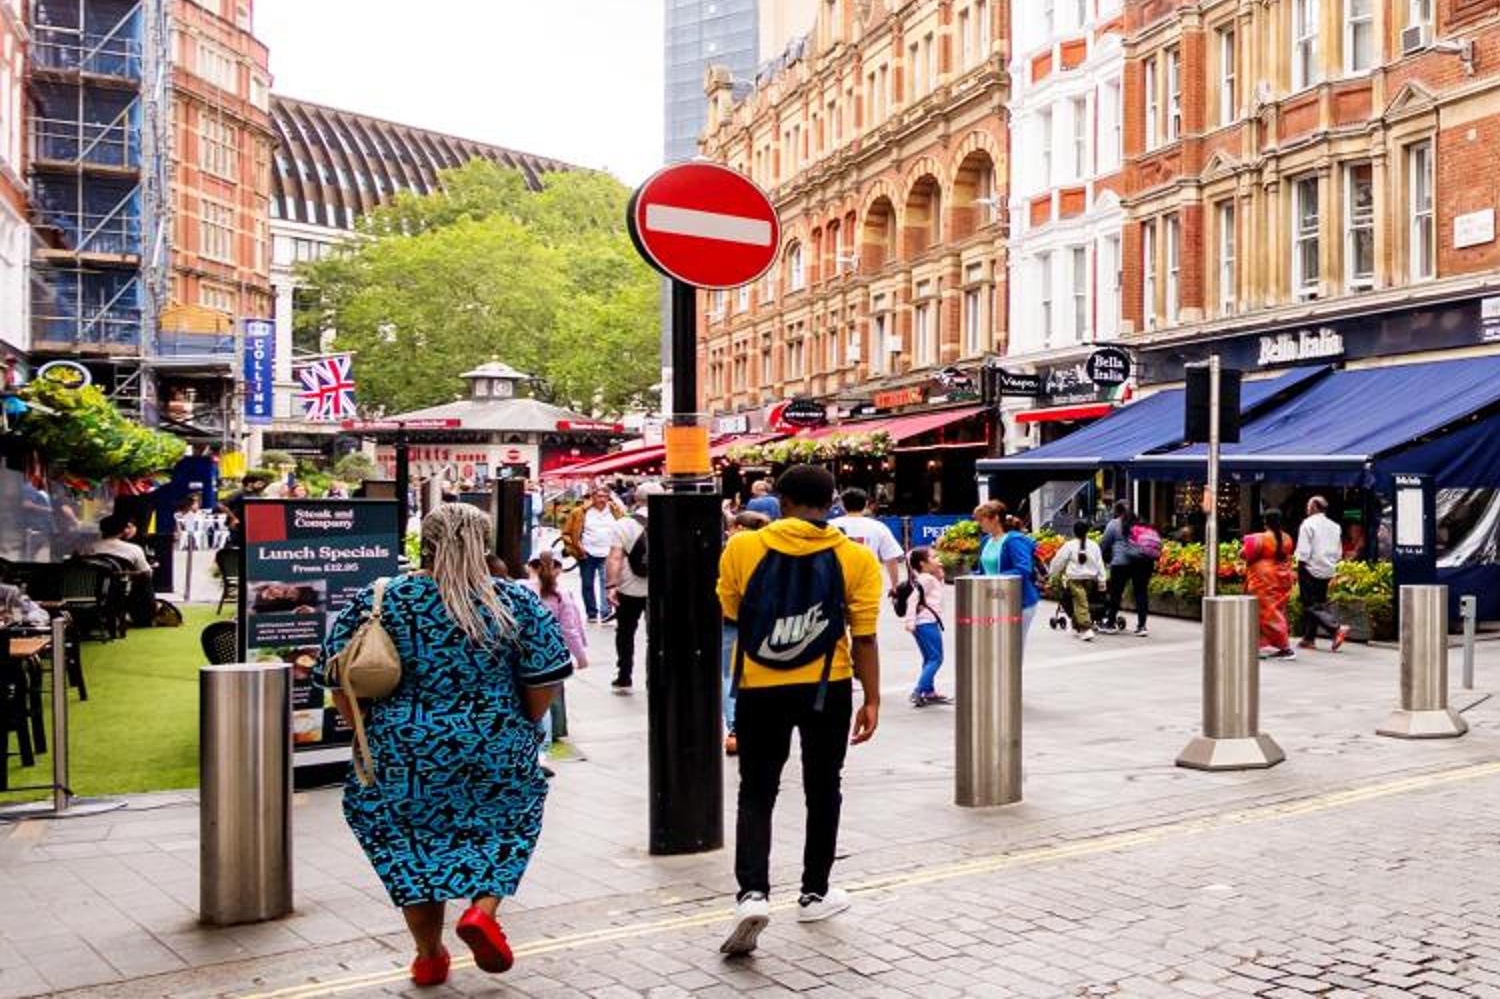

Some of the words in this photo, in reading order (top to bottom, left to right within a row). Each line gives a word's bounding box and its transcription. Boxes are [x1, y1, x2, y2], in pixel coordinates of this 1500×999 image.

[1094, 354, 1124, 368] Bella
[253, 339, 265, 414] COLLINS
[1094, 367, 1125, 381] Italia
[295, 509, 332, 519] Steak
[294, 518, 353, 530] Company
[258, 546, 315, 560] Lunch
[319, 545, 390, 561] Specials
[292, 564, 322, 573] From
[769, 601, 824, 646] NIKE
